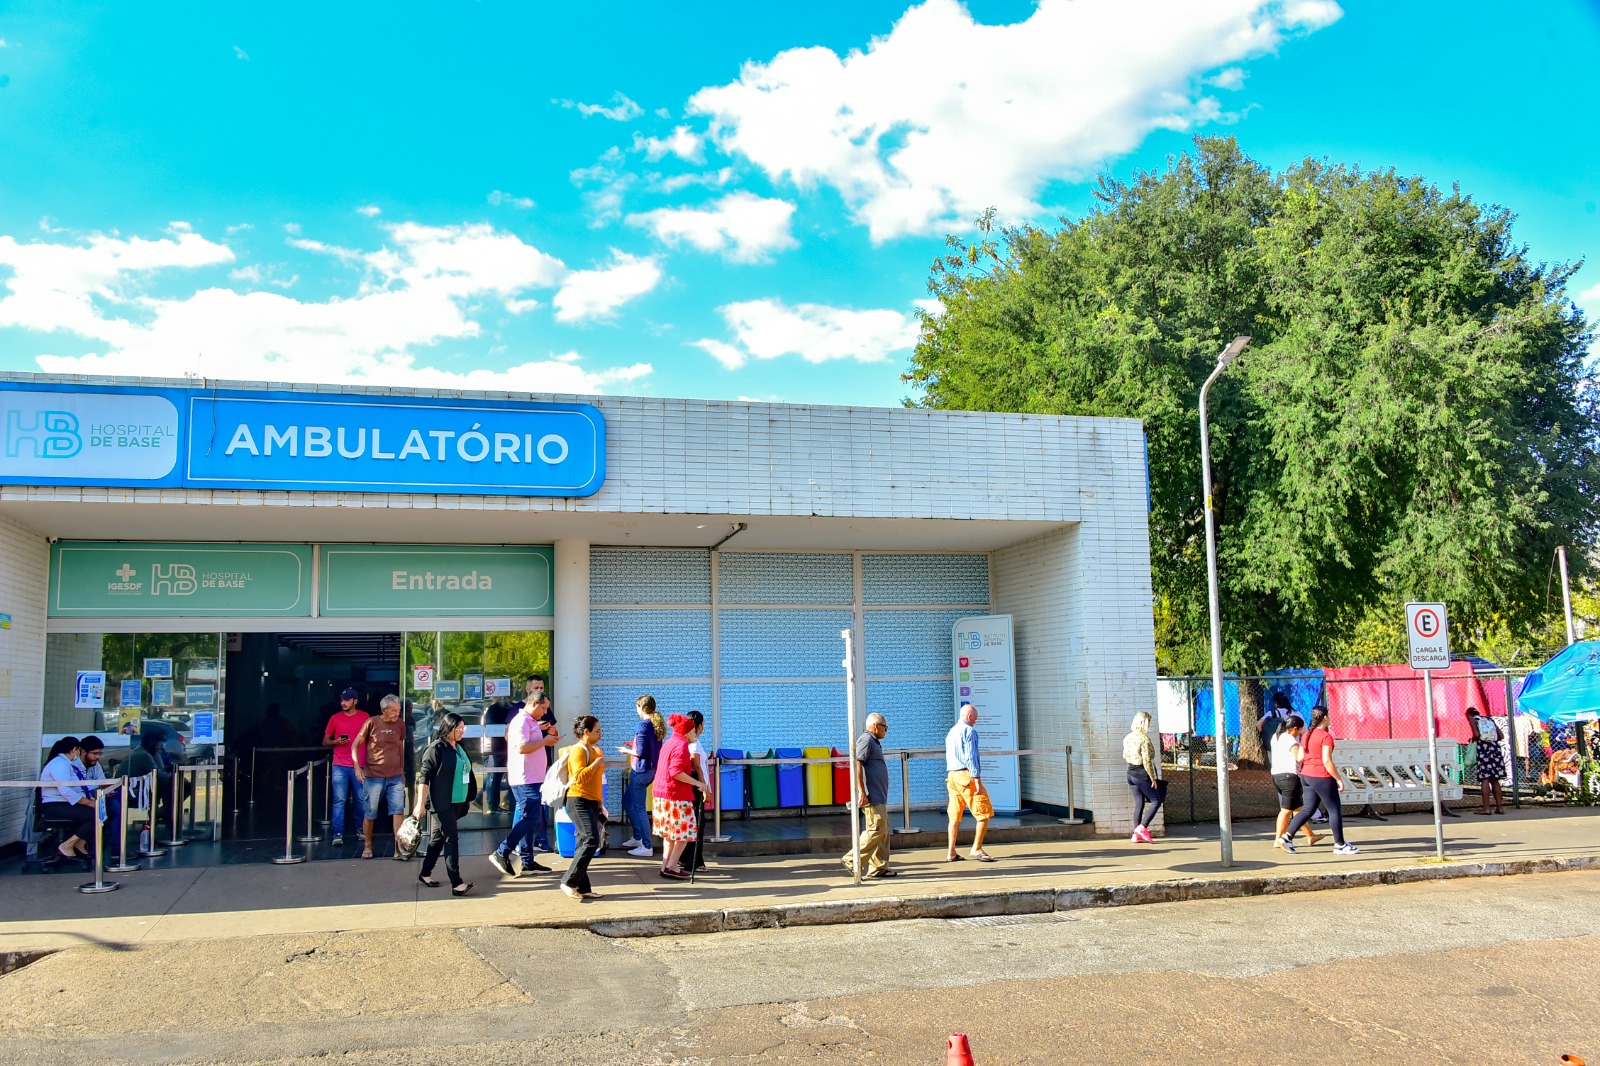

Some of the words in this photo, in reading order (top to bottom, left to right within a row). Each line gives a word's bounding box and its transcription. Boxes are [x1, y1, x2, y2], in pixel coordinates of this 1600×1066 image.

[91, 424, 175, 437] HOSPITAL
[90, 436, 113, 447] DE
[117, 437, 161, 448] BASE
[225, 423, 569, 464] AMBULATÓRIO
[202, 572, 254, 581] HOSPITAL
[391, 570, 494, 590] Entrada
[107, 582, 143, 591] IGESDF
[201, 580, 216, 588] DE
[218, 580, 246, 588] BASE
[1422, 615, 1431, 631] E
